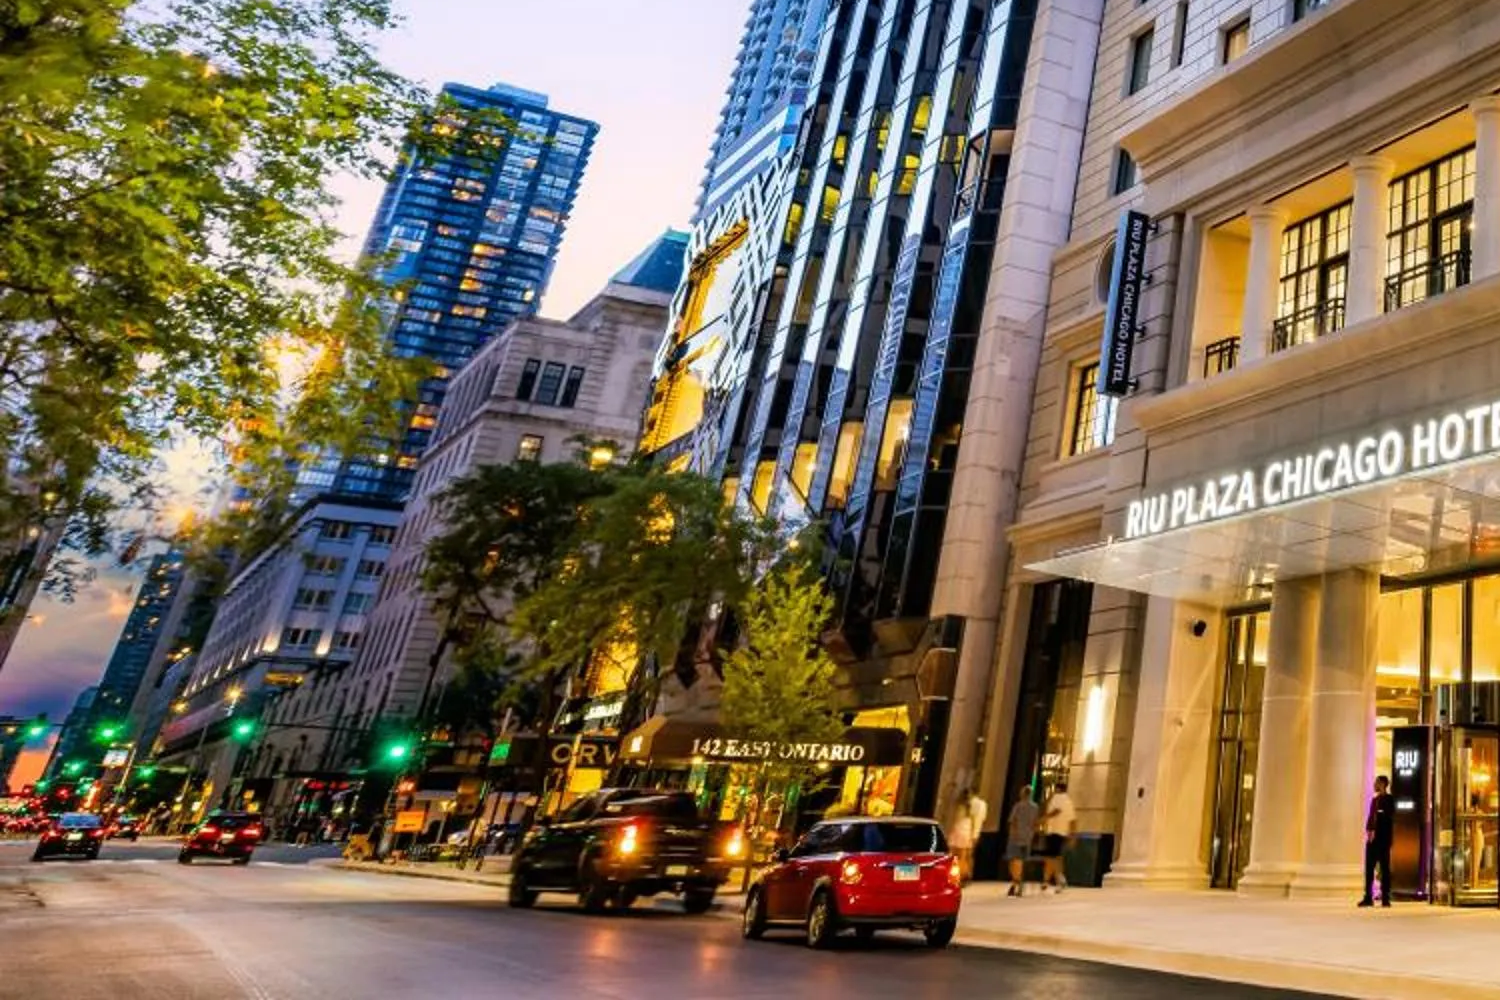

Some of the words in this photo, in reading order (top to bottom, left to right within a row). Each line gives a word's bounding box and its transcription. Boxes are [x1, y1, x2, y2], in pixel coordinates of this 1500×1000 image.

[1131, 219, 1143, 241] RIU
[1126, 241, 1141, 281] PLAZA
[1118, 283, 1135, 340] CHICAGO
[1112, 341, 1128, 384] HOTEL
[1126, 496, 1166, 539] RIU
[1170, 470, 1255, 527] PLAZA
[1263, 430, 1404, 502] CHICAGO
[692, 738, 720, 756] 142
[724, 740, 776, 758] EAST
[779, 743, 865, 761] ONTARIO
[1395, 751, 1418, 769] RIU
